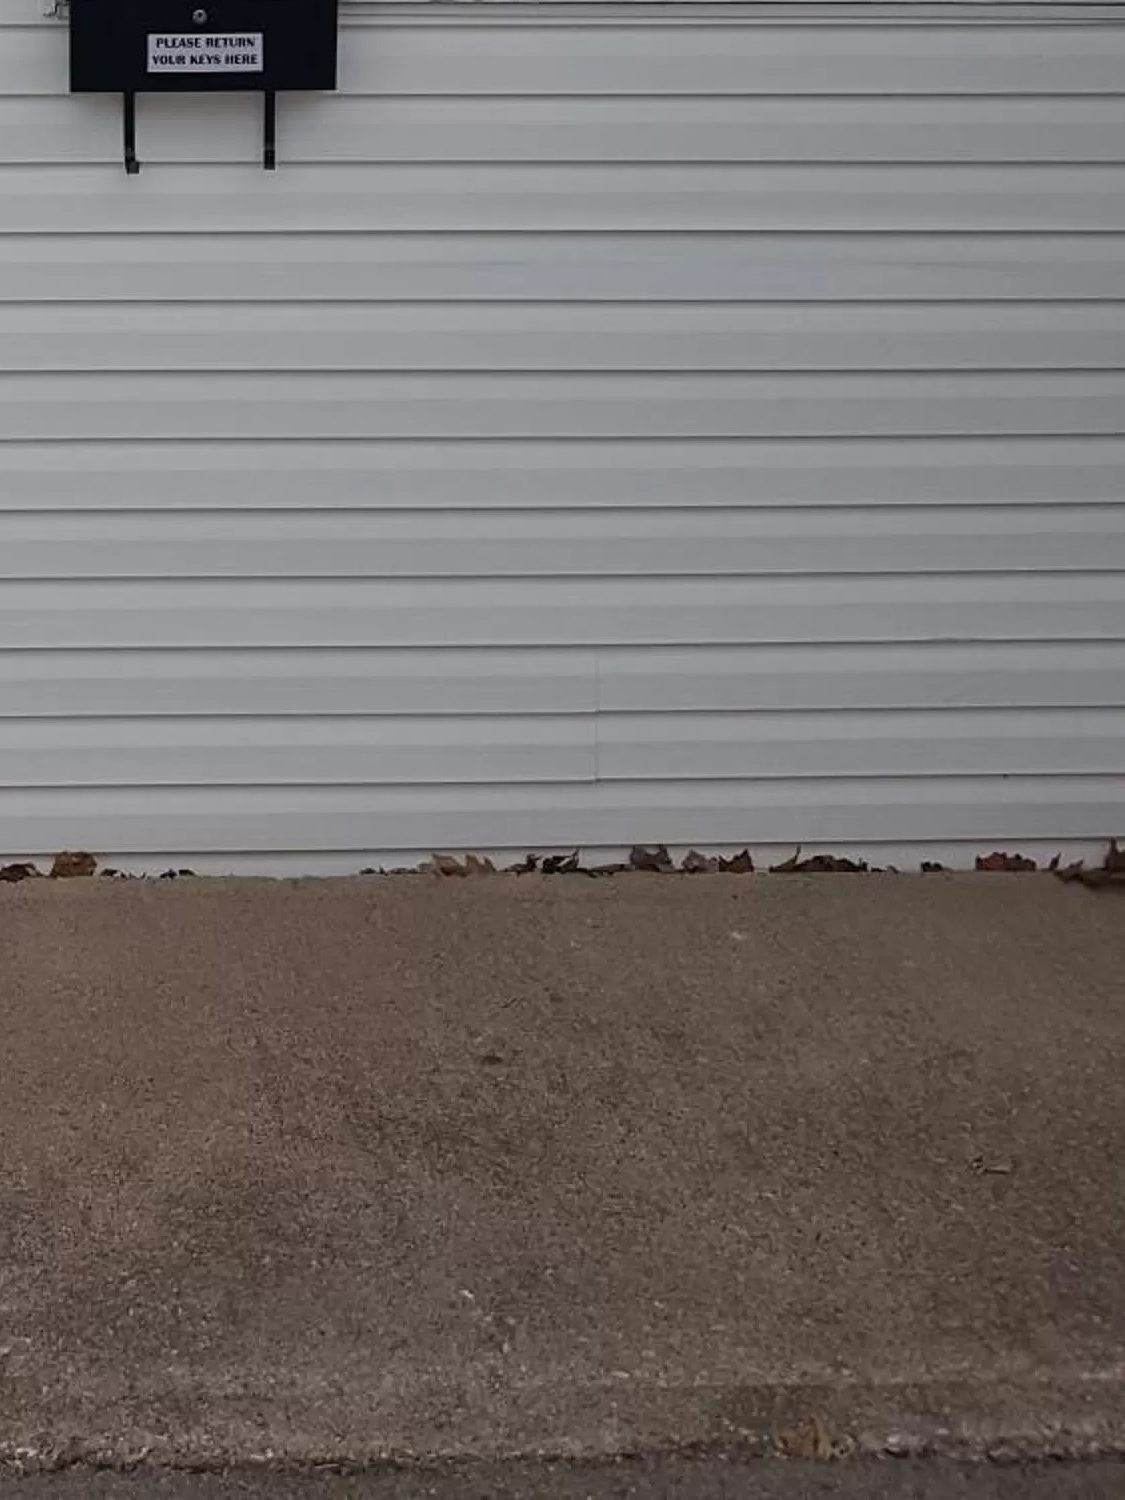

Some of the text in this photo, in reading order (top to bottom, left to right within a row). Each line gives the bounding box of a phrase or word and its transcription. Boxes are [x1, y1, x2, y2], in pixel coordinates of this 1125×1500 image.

[156, 37, 255, 49] PLEASE RETURN
[152, 53, 258, 65] YOUR KEYS HERE
